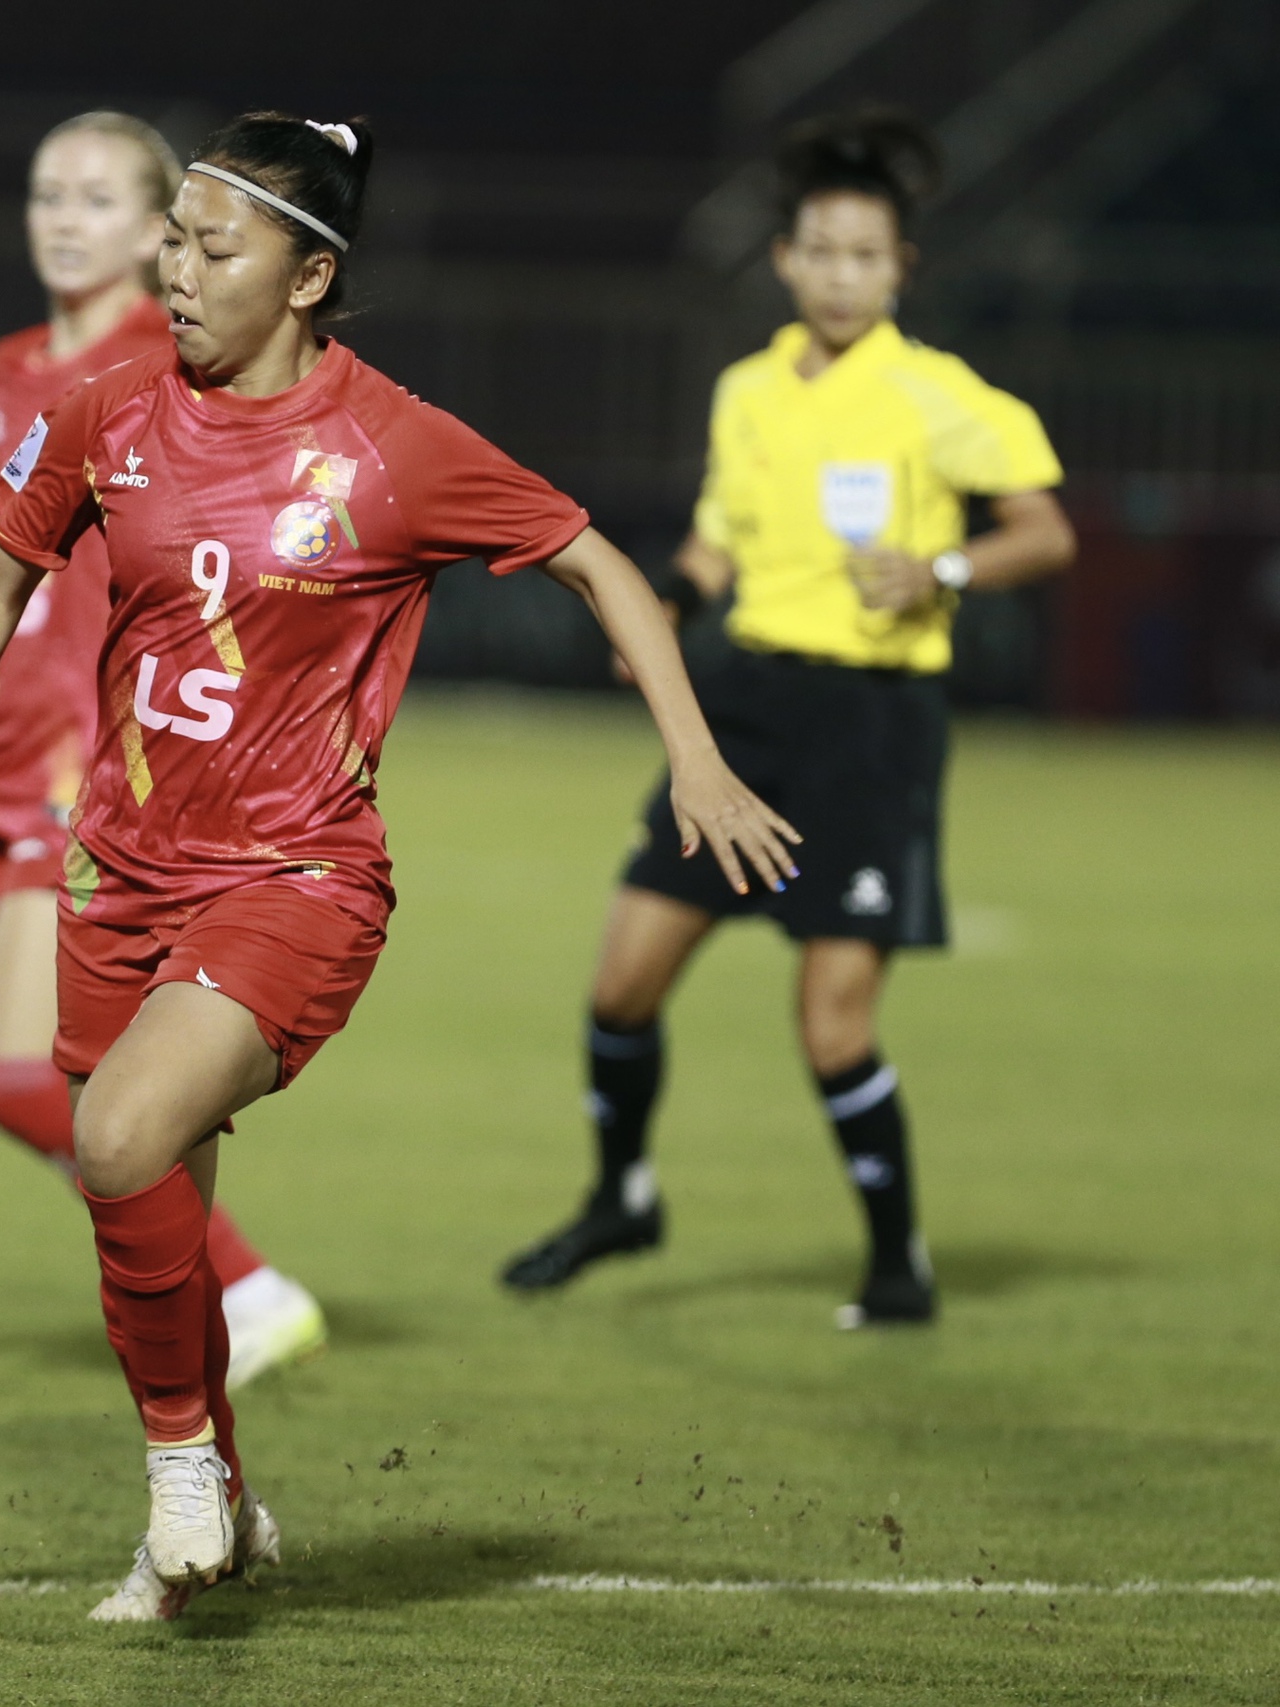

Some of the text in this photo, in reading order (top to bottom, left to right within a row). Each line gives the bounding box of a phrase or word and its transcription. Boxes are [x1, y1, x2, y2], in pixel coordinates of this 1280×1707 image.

[191, 539, 231, 620] 9
[258, 573, 336, 594] VIET NAM
[133, 652, 242, 742] LS
